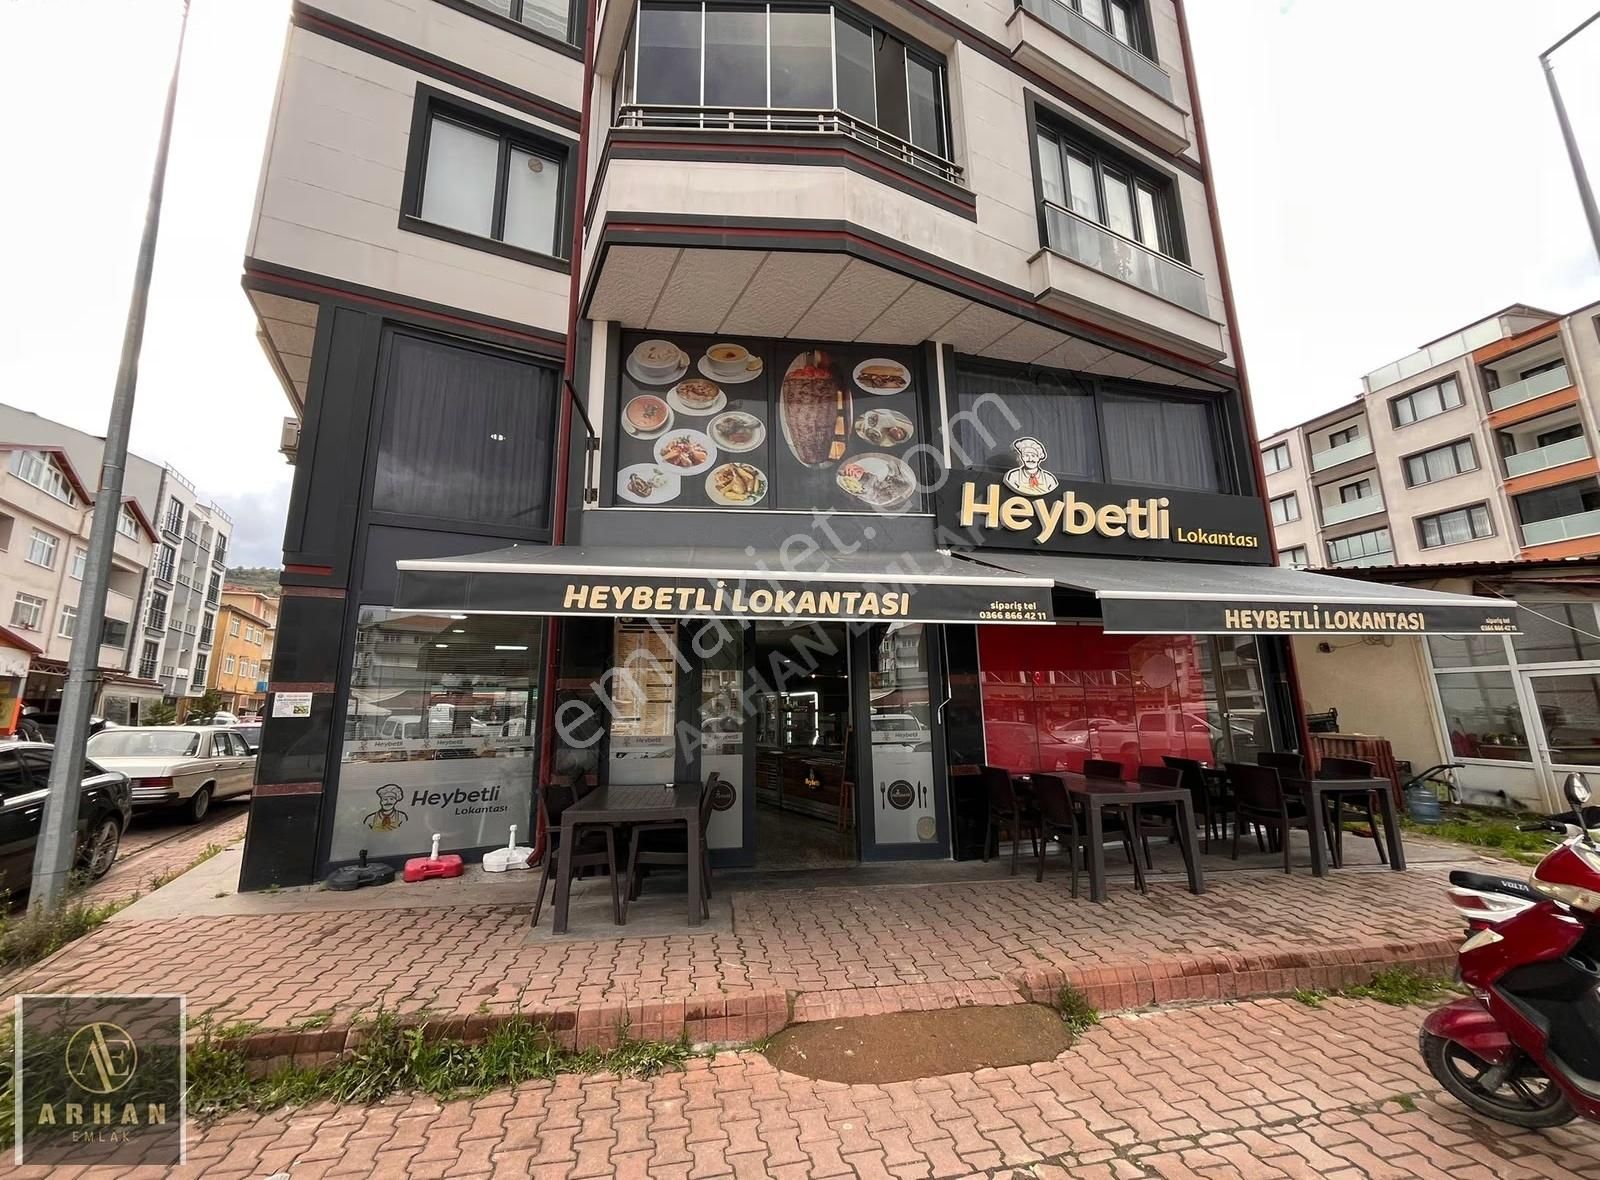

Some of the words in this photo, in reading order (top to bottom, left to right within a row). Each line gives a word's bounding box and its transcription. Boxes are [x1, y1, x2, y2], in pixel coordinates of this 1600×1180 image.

[960, 481, 1170, 545] Heybetli
[1177, 527, 1258, 548] Lokantası
[563, 580, 725, 612] HEYBETLİ
[732, 588, 911, 616] LOKANTASI
[990, 601, 1022, 611] sipariş
[1023, 602, 1037, 610] tel
[979, 611, 1003, 619] 0366
[1004, 611, 1023, 620] 866
[1024, 612, 1037, 620] 42
[1037, 612, 1047, 620] 11
[1224, 605, 1320, 630] HEYBETLİ
[1324, 610, 1425, 631] LOKANTASI
[411, 785, 501, 809] Heybetli
[455, 806, 508, 816] Lokantası
